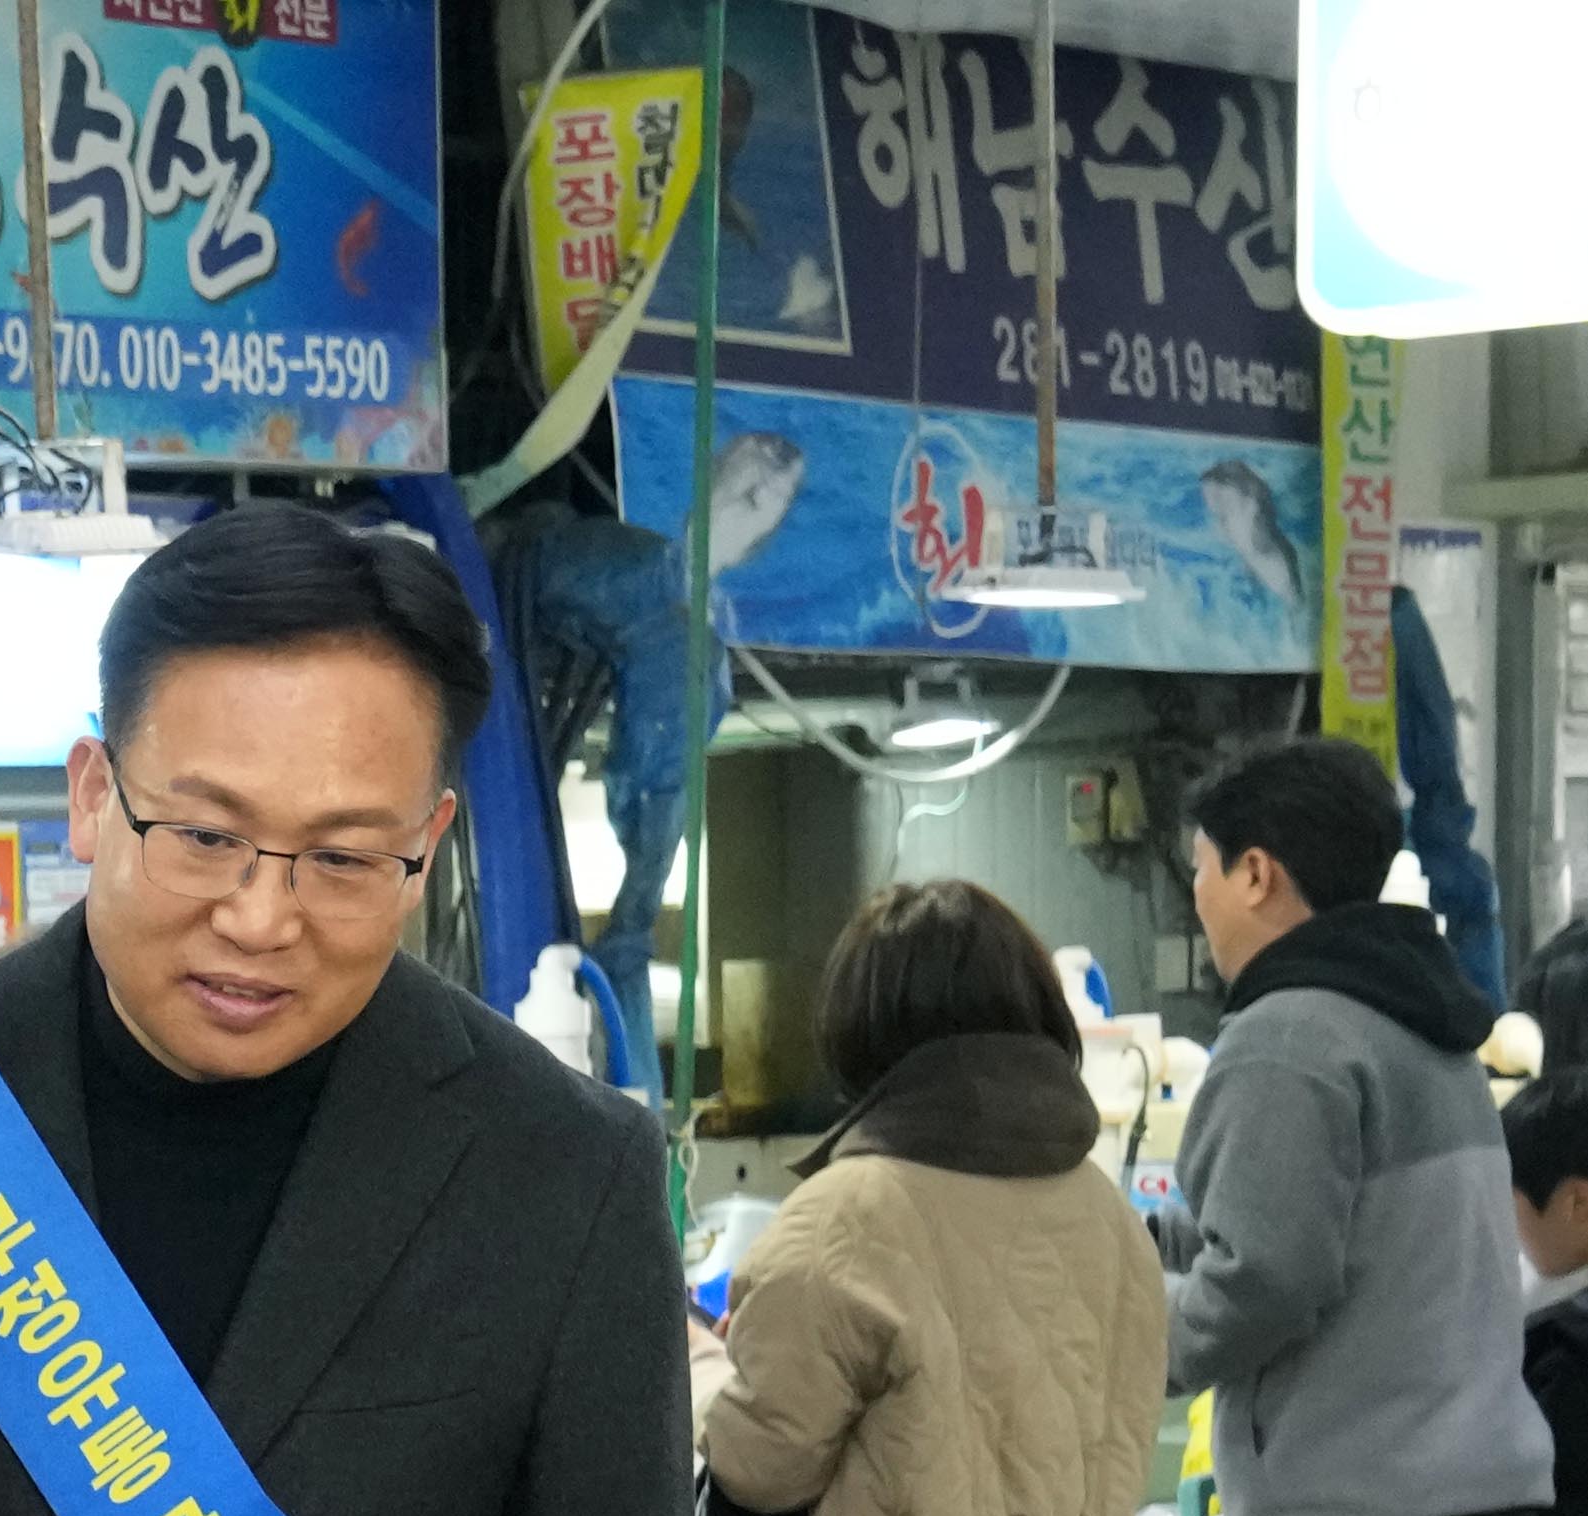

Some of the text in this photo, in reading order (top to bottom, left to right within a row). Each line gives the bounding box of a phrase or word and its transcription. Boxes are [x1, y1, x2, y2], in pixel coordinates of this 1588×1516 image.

[35, 40, 271, 290] 수산
[842, 24, 1296, 310] 해남수산
[119, 325, 390, 402] 010-3485-5590
